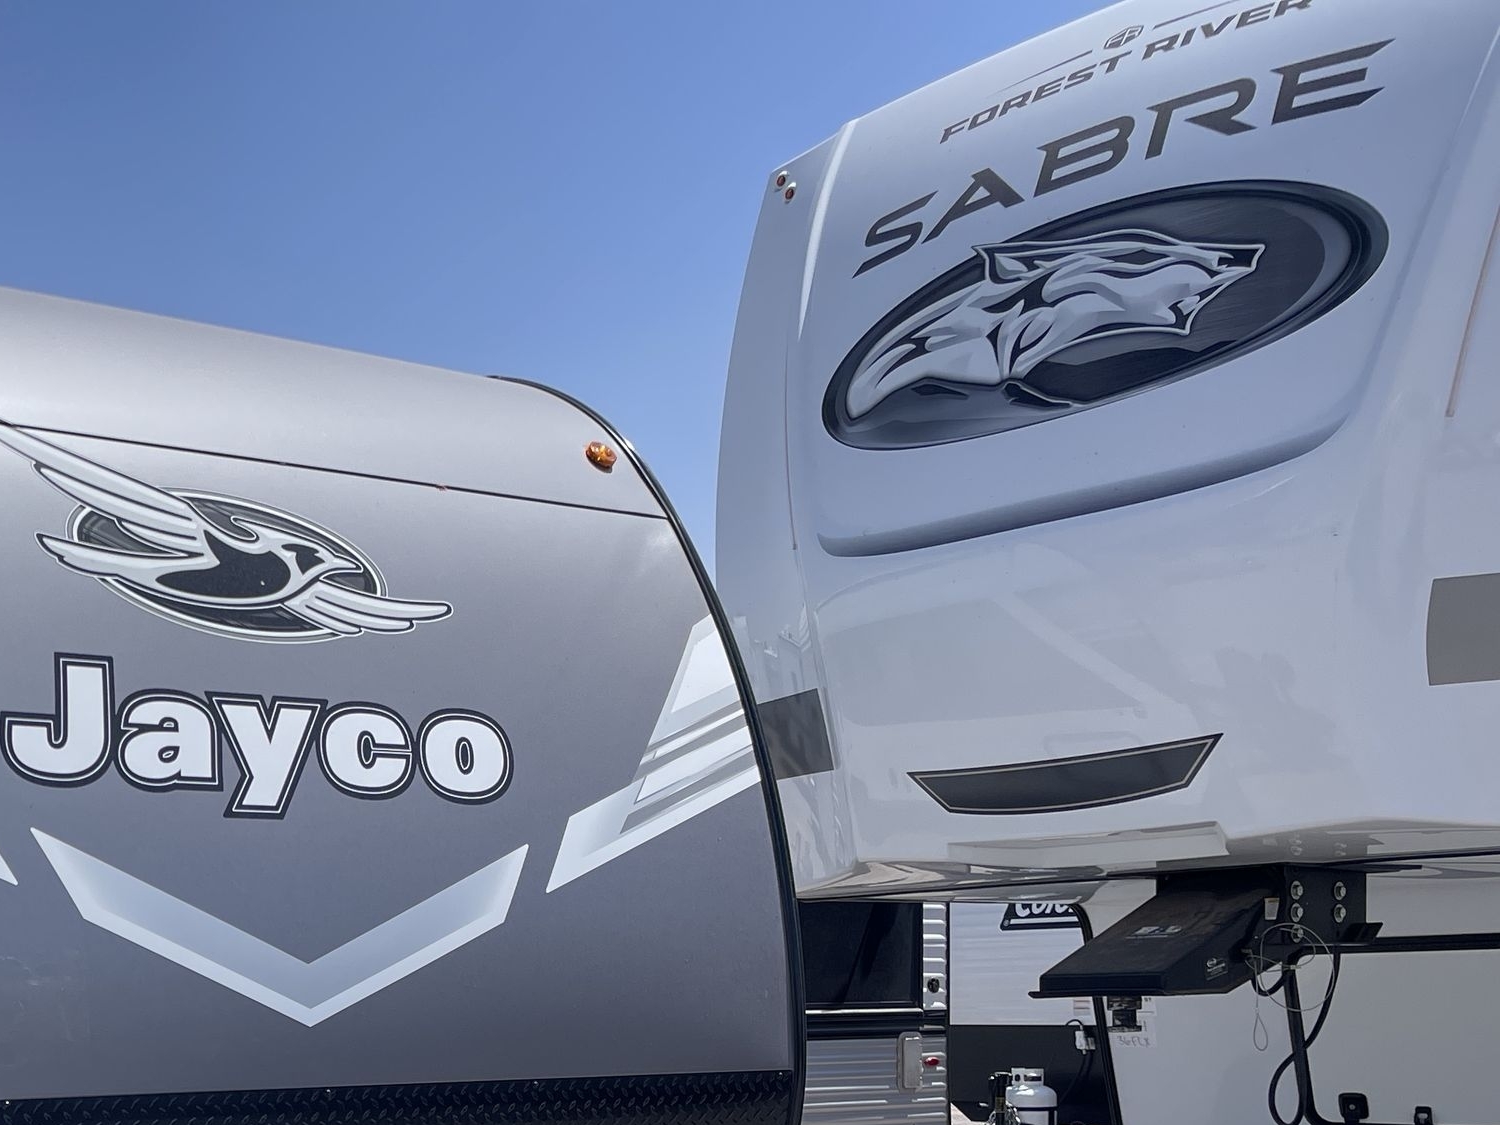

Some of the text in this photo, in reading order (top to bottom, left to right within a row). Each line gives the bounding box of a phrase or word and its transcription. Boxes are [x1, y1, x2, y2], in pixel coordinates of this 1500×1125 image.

[939, 0, 1312, 144] FOREST RIVER
[852, 38, 1396, 279] SABRE
[0, 652, 514, 820] Jayco
